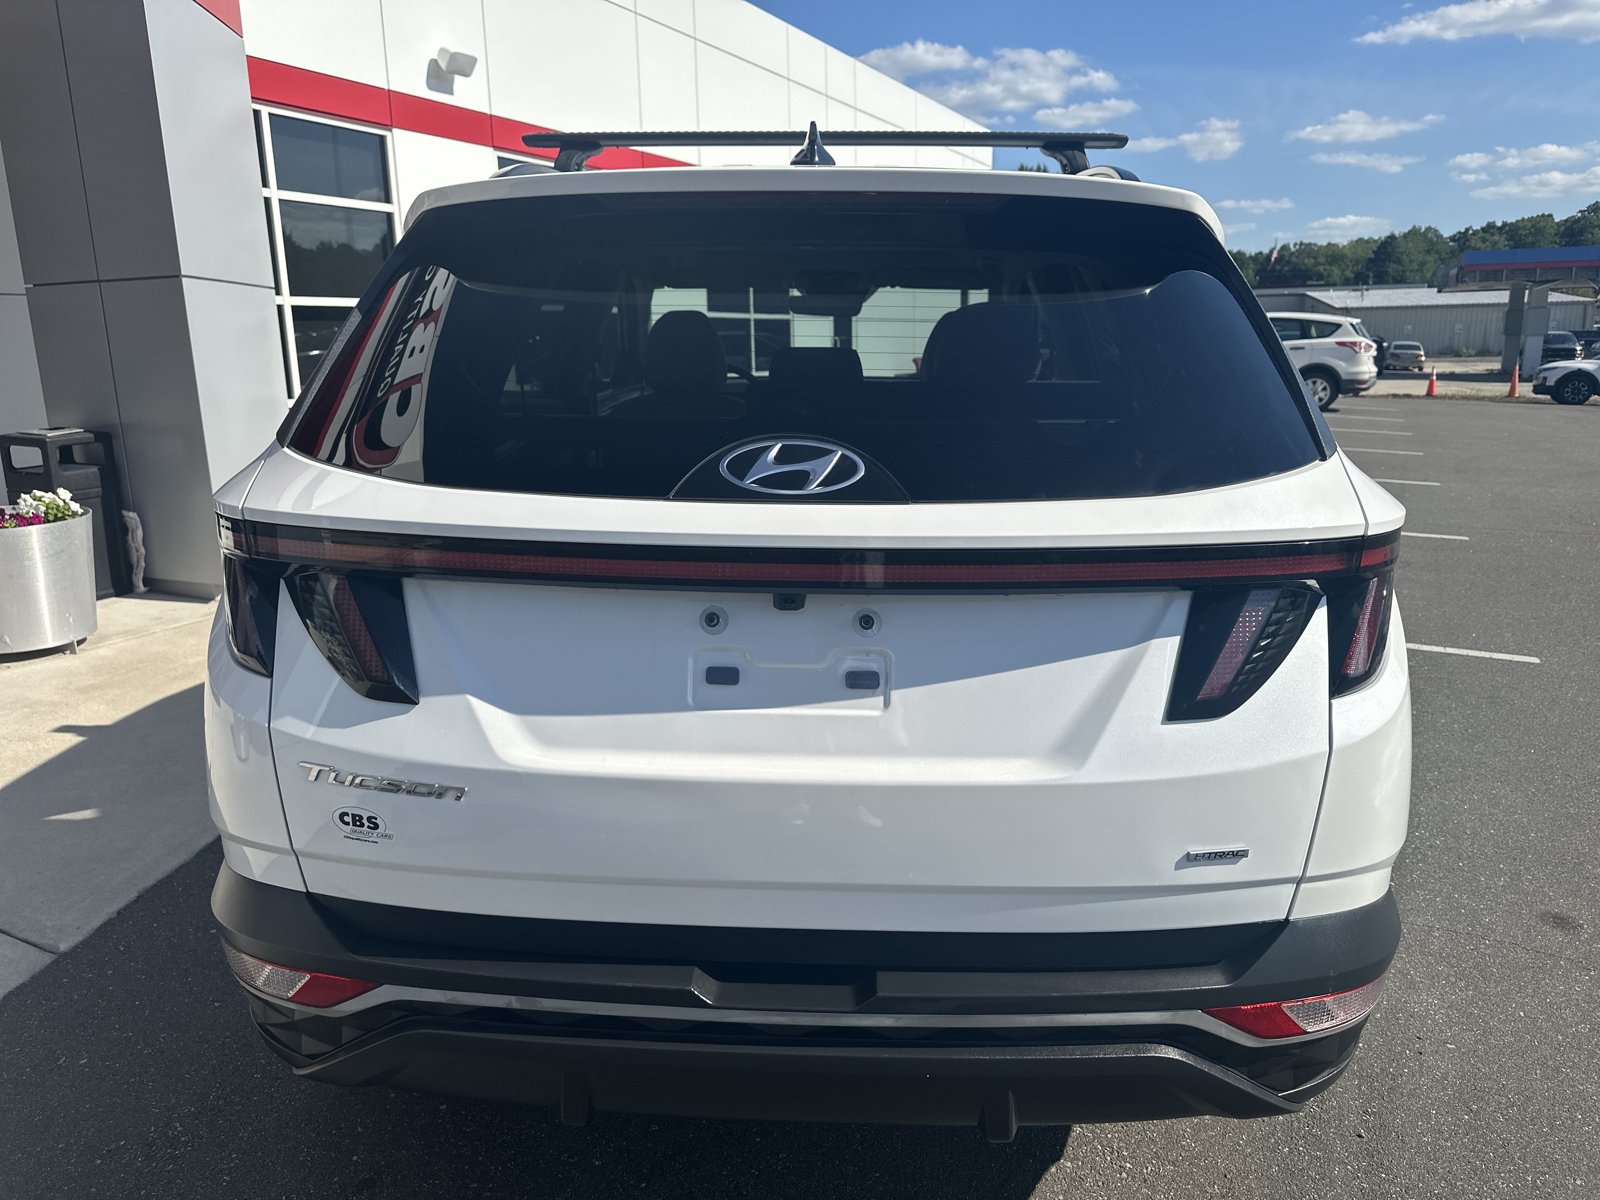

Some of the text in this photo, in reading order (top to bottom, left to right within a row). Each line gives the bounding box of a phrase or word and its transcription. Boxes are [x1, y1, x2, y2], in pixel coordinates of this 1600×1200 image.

[338, 811, 380, 831] CBS
[351, 828, 393, 840] QUALITY CARS
[1194, 849, 1246, 861] HTRAC
